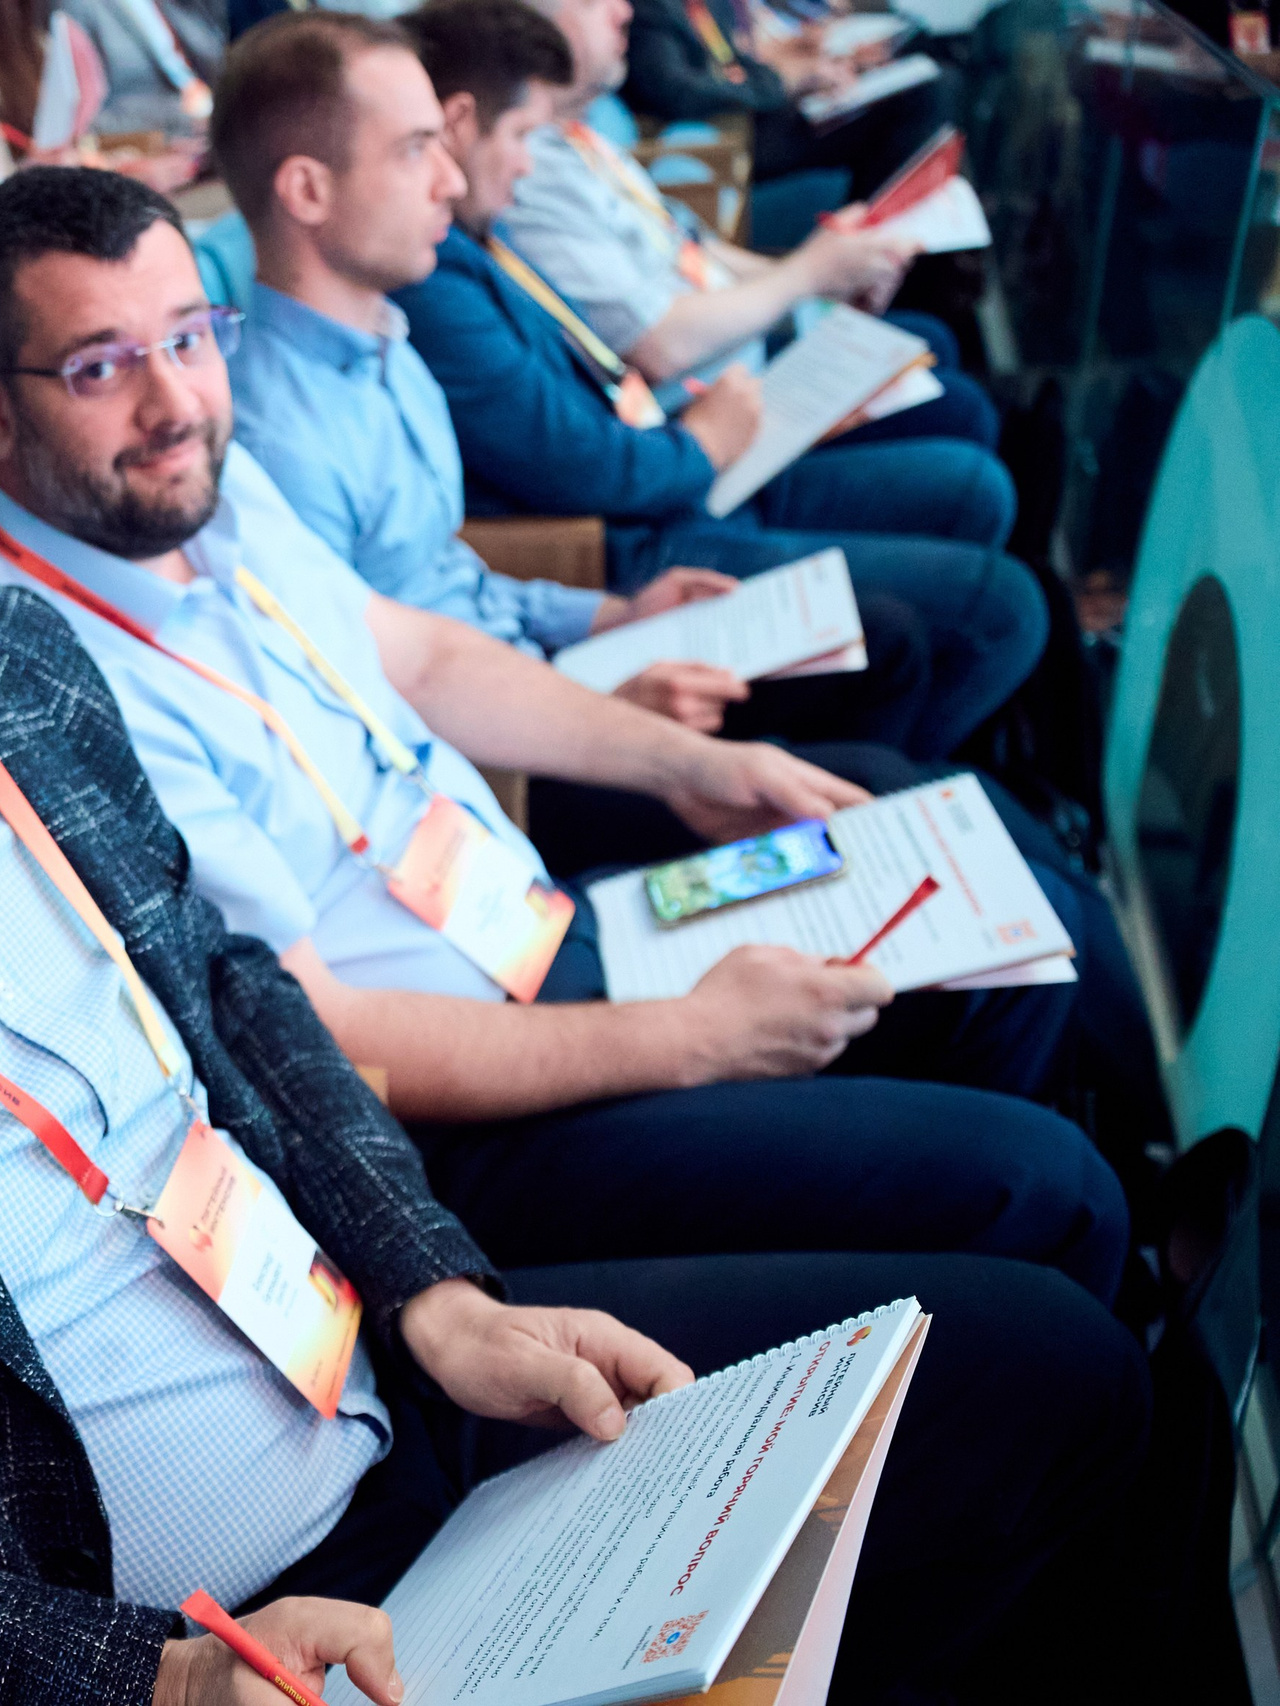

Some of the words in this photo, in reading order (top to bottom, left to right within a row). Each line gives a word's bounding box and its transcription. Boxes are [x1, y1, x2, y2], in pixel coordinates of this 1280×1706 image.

[780, 1341, 831, 1418] ОТКРЫТИЕ:
[808, 1356, 846, 1418] ИНТЕНСИВ
[733, 1364, 795, 1456] Индивидуальная
[713, 1422, 735, 1449] своей
[758, 1420, 786, 1454] МОЙ
[686, 1451, 716, 1491] текущей
[706, 1459, 736, 1498] работа
[714, 1457, 764, 1526] ГОРЯЧИЙ
[655, 1493, 689, 1540] ситуации
[584, 1541, 620, 1589] образом,
[645, 1542, 658, 1556] на
[670, 1529, 719, 1596] ВОПРОС
[621, 1557, 649, 1594] работе
[477, 1581, 539, 1665] эффективности
[504, 1598, 538, 1643] отрасли
[563, 1590, 588, 1623] чтобы
[534, 1615, 560, 1652] вопрос
[551, 1625, 565, 1641] вы
[589, 1617, 611, 1642] том,
[490, 1623, 532, 1679] развитию
[514, 1656, 534, 1680] был
[528, 1653, 547, 1676] нем
[453, 1668, 478, 1700] моего
[470, 1654, 499, 1694] целом?
